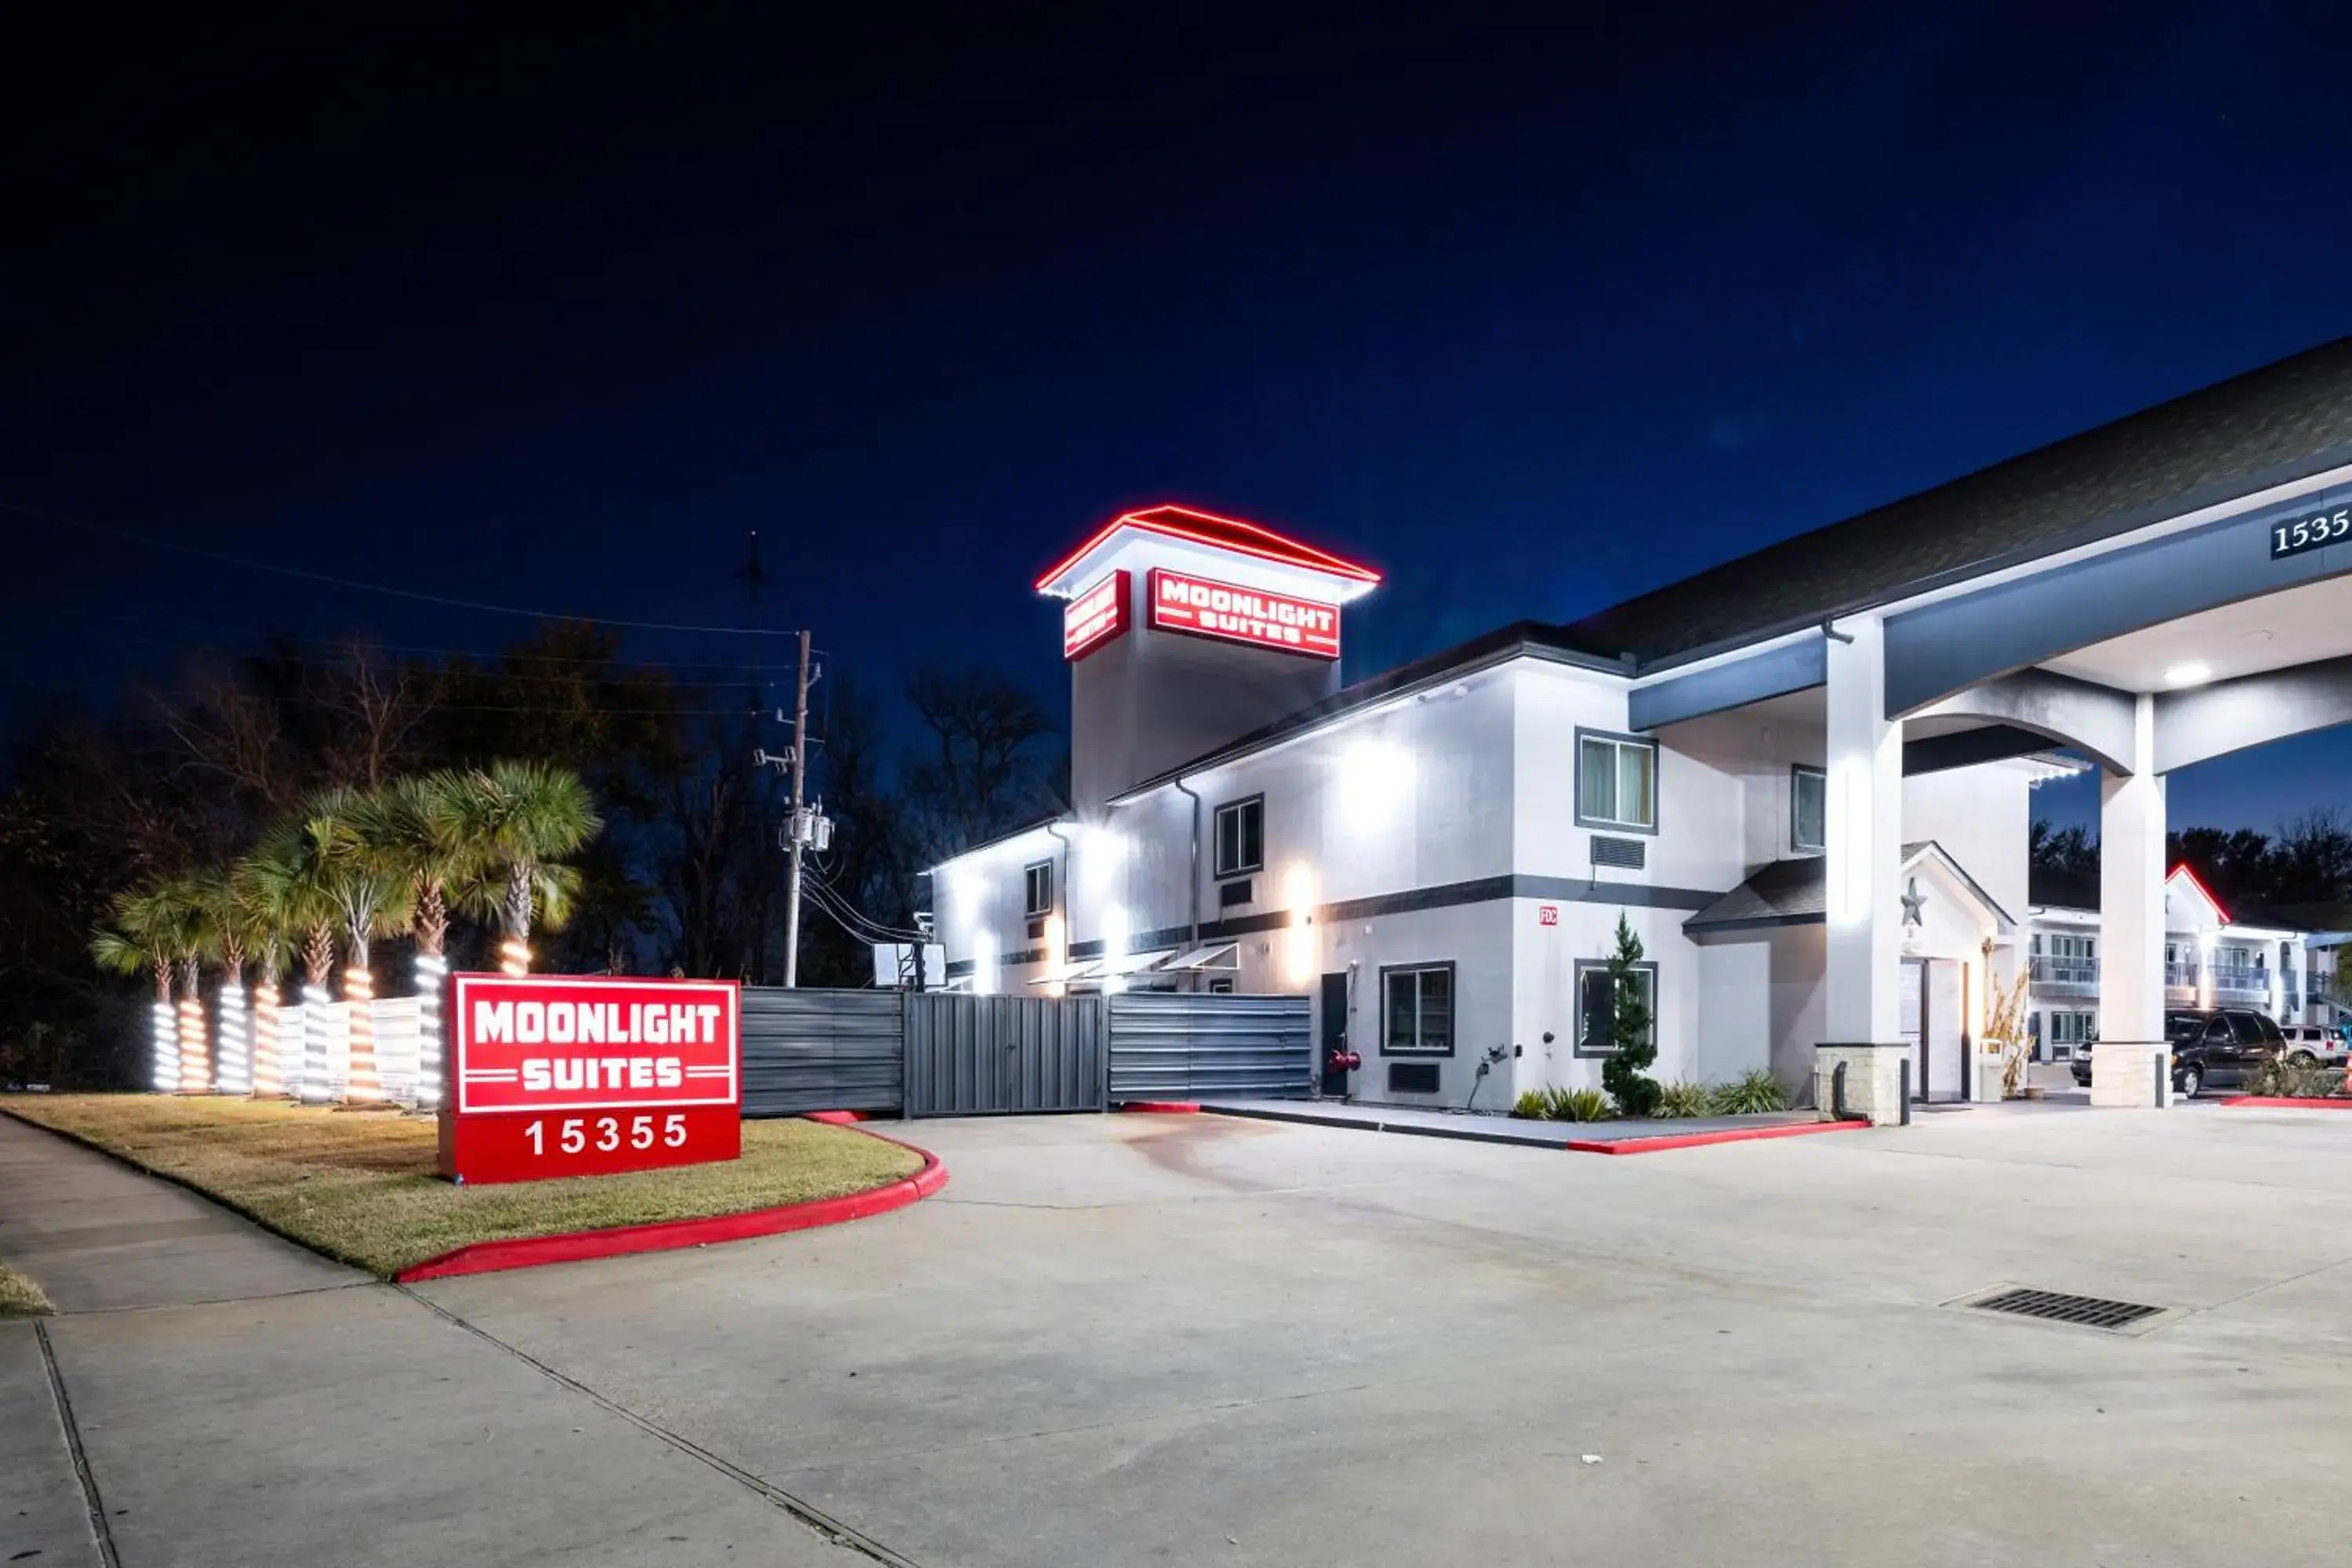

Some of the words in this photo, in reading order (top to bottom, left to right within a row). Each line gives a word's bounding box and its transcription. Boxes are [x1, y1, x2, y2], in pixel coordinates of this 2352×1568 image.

[1161, 579, 1333, 631] MOONLIGHT
[1199, 611, 1301, 643] SUITES
[1541, 909, 1557, 923] FDC
[474, 1001, 720, 1044] MOONLIGHT
[522, 1058, 682, 1091] SUITES
[524, 1114, 687, 1155] 15355
